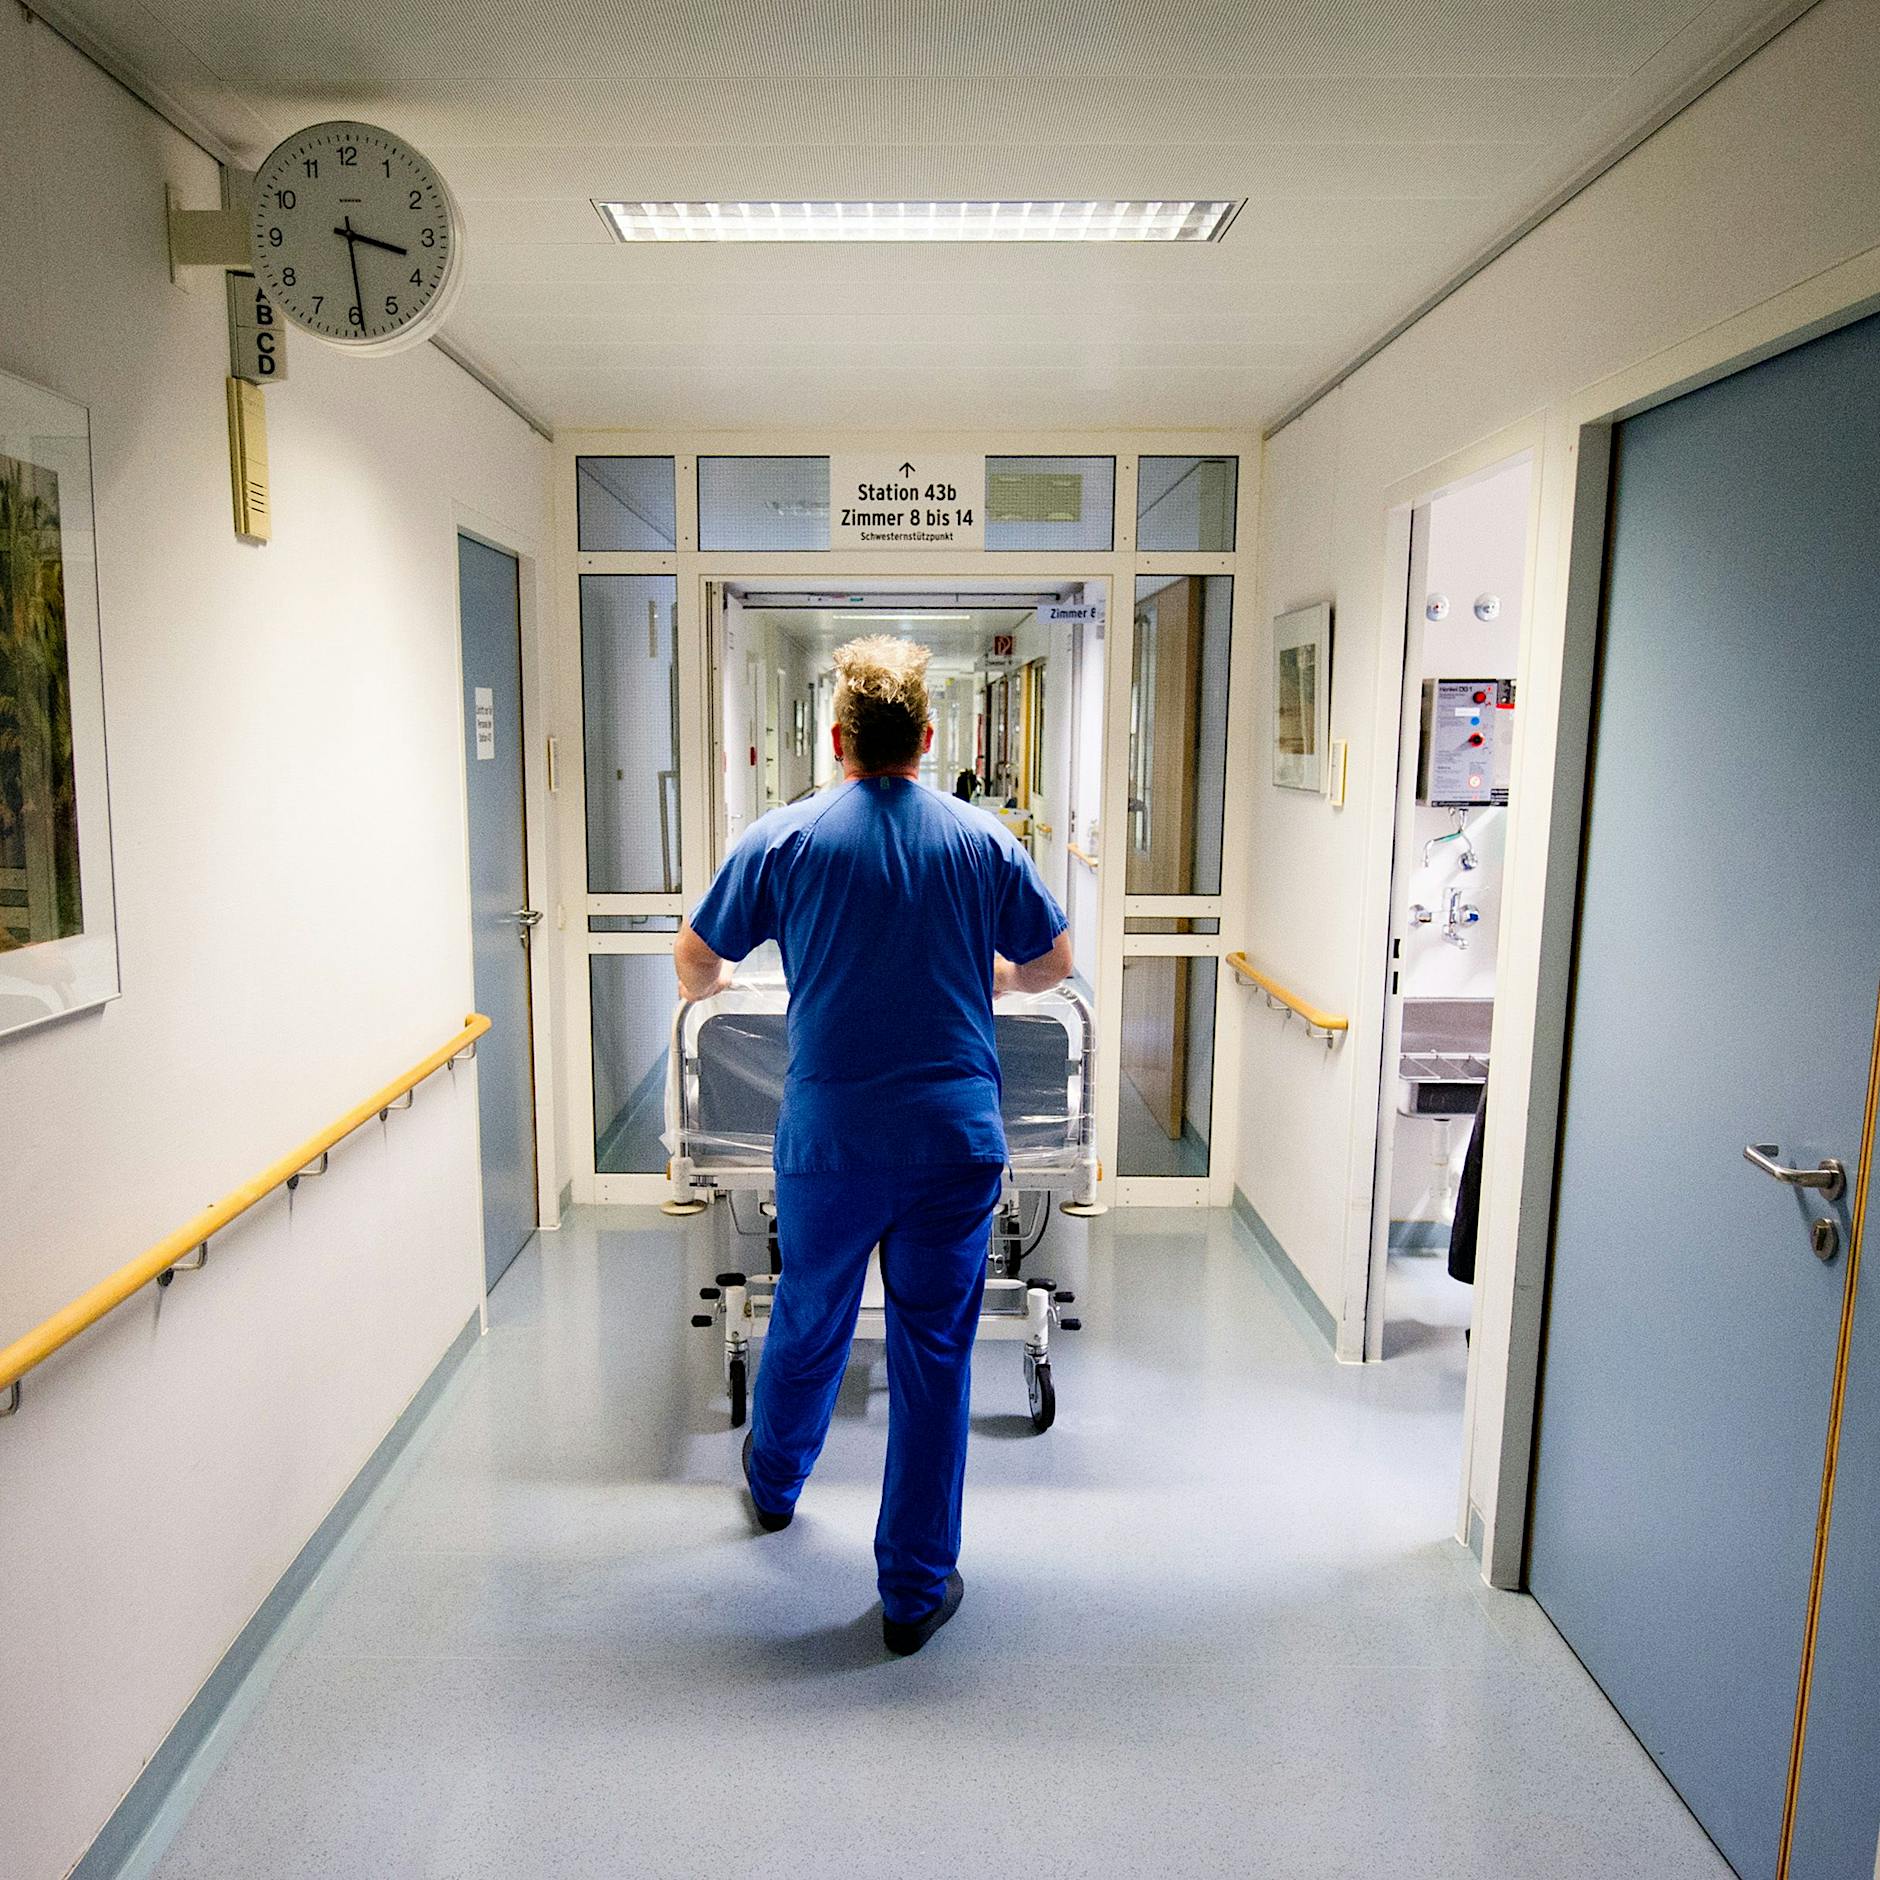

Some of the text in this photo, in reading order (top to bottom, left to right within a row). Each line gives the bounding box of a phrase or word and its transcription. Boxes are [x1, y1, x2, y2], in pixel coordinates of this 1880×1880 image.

[337, 147, 356, 165] 12
[303, 159, 318, 178] 11
[382, 160, 389, 178] 1
[274, 190, 296, 209] 10
[410, 191, 421, 209] 2
[270, 228, 282, 247] 9
[422, 229, 434, 247] 3
[283, 267, 296, 286] 8
[410, 269, 422, 286] 4
[312, 297, 323, 314] 7
[386, 296, 398, 315] 5
[257, 305, 273, 325] B
[348, 307, 362, 325] 6
[257, 332, 274, 353] C
[258, 355, 275, 374] D
[858, 484, 957, 501] Station 43b
[841, 509, 974, 526] Zimmer 8 bis 14
[861, 532, 953, 542] Schwesternstützpunkt
[1050, 608, 1088, 619] Zimmer
